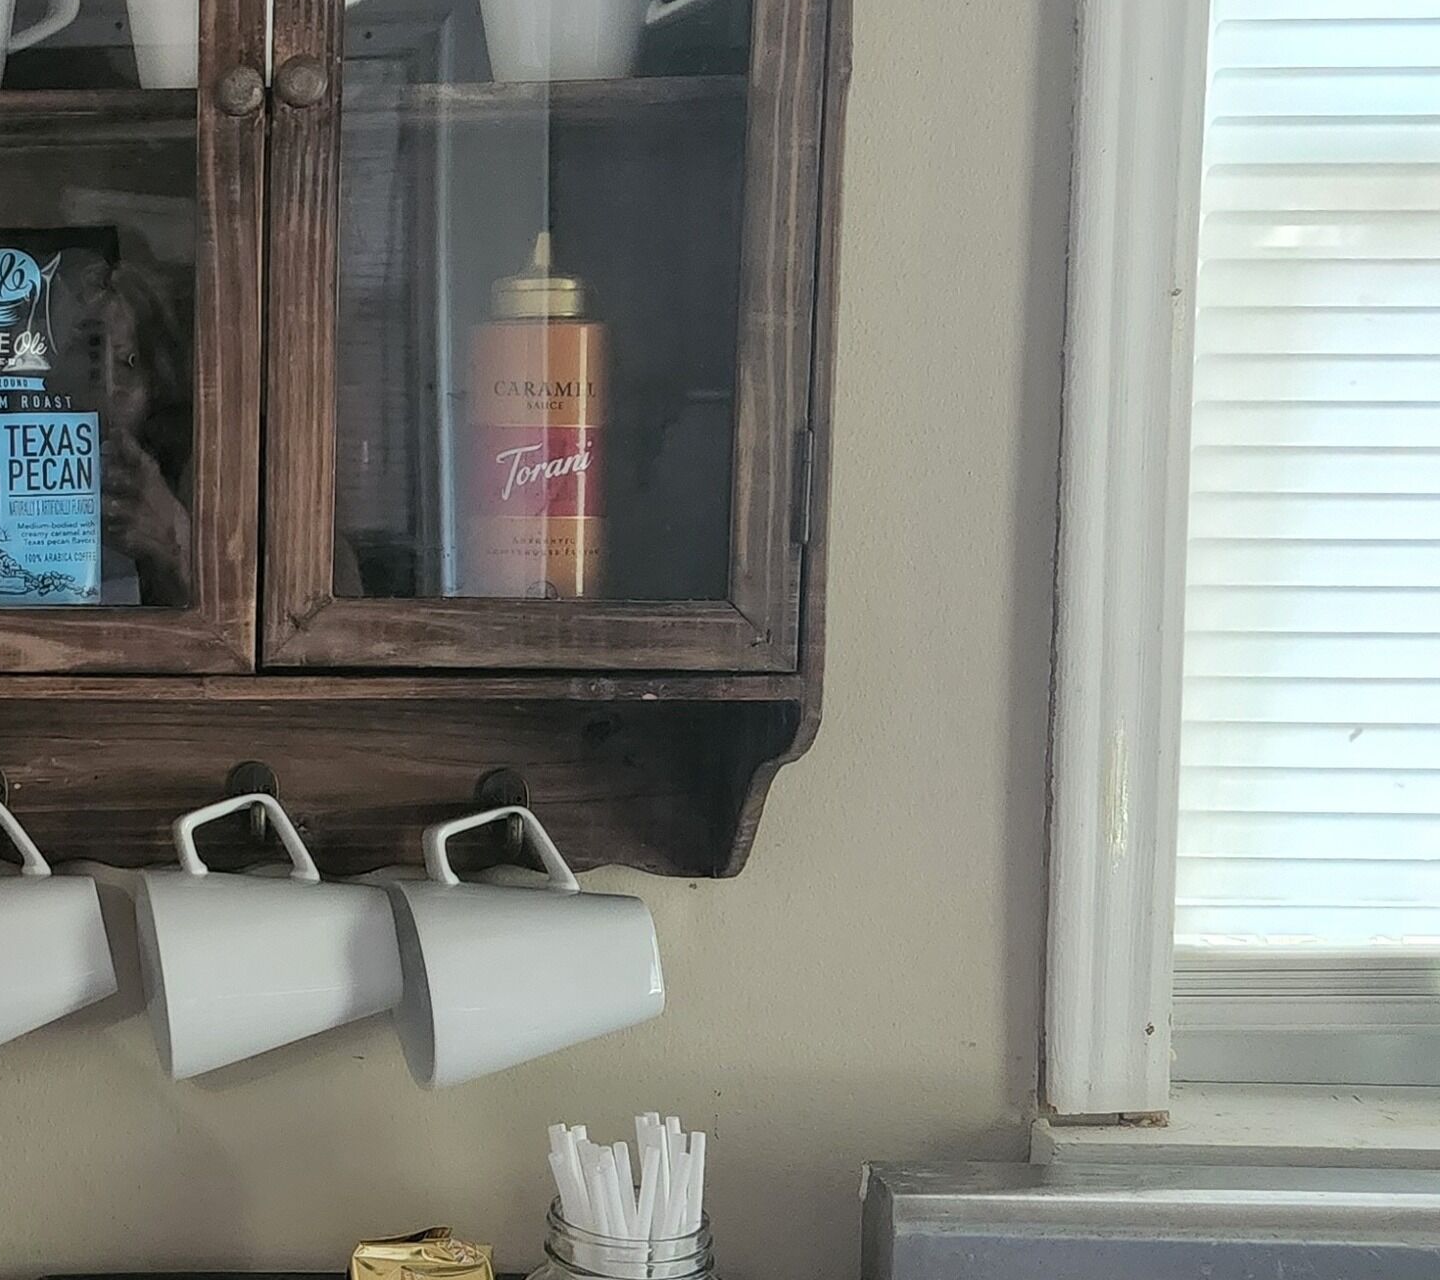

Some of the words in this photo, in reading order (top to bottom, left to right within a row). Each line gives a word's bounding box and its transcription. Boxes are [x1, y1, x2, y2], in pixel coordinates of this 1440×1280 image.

[14, 331, 48, 355] Olé
[21, 395, 72, 409] ROAST
[4, 423, 92, 457] TEXAS
[9, 457, 92, 491] PECAN
[496, 439, 593, 501] Torani
